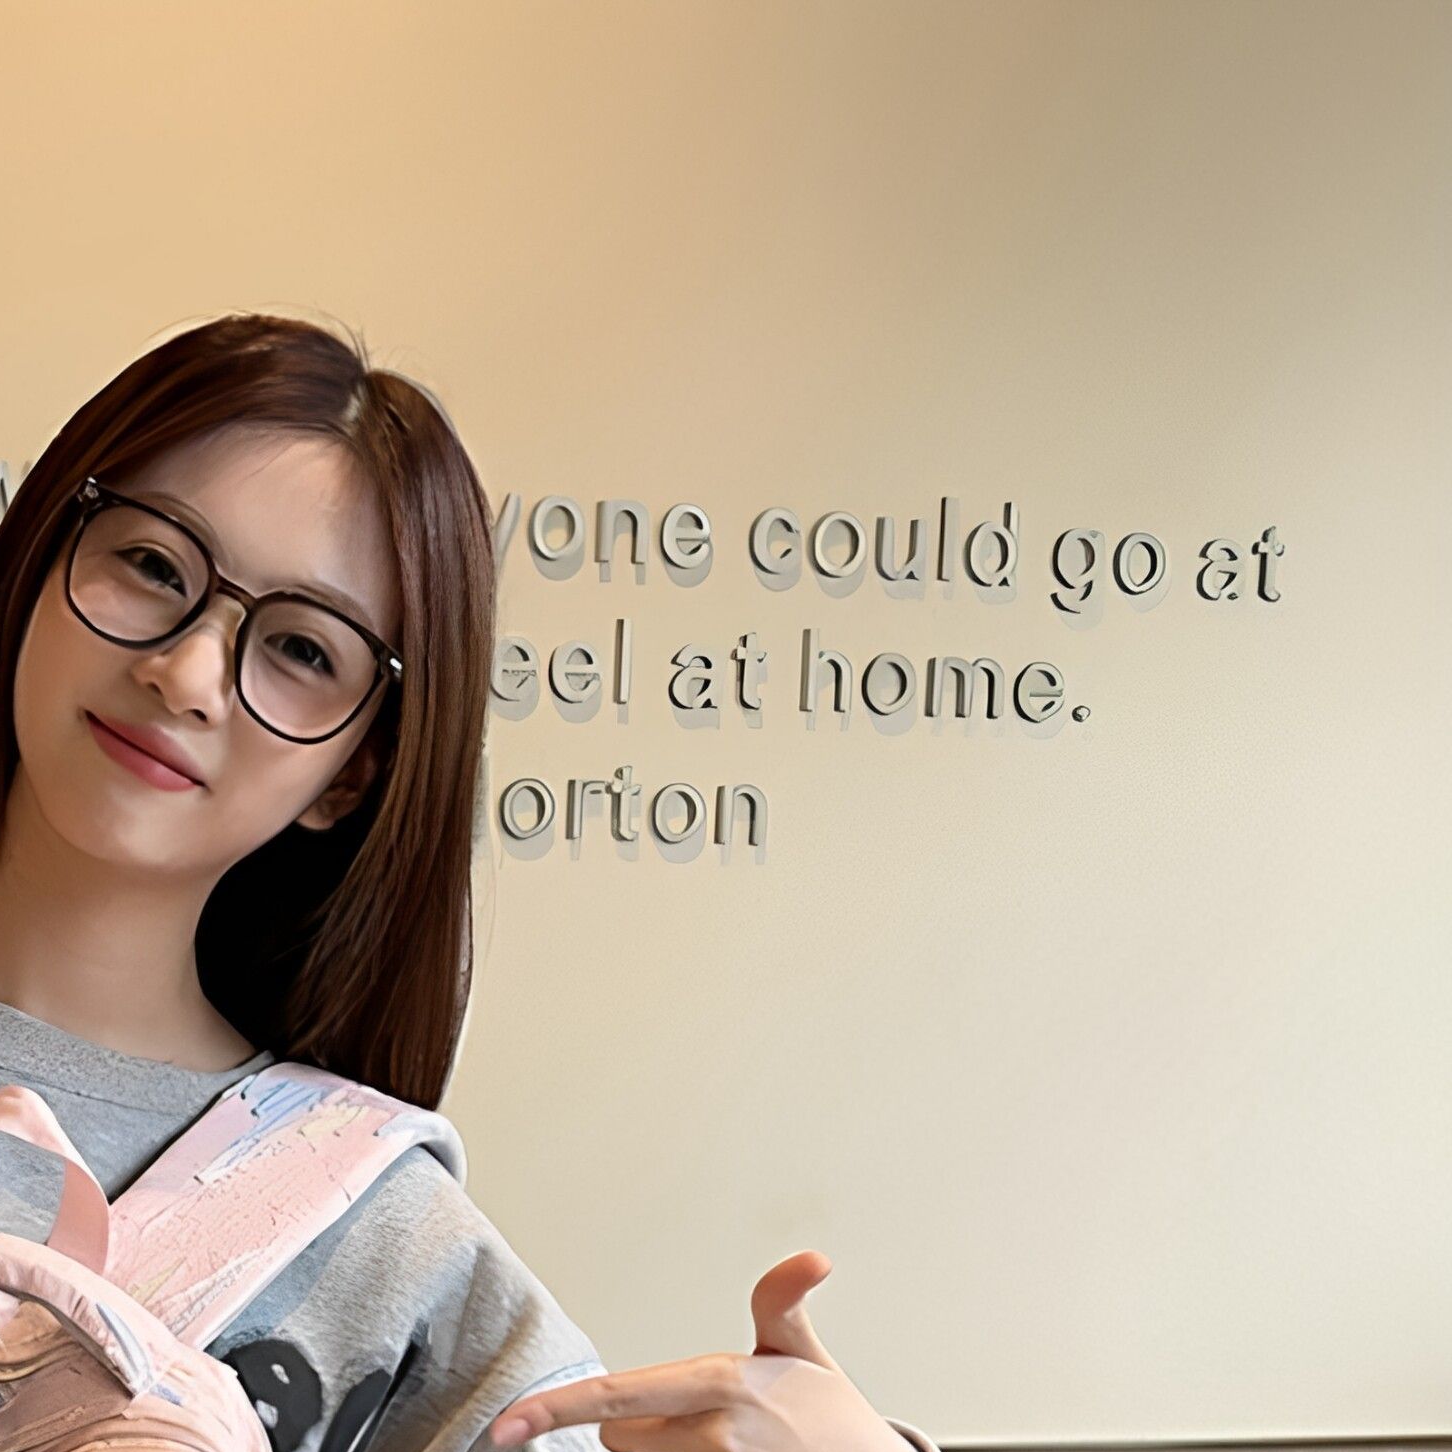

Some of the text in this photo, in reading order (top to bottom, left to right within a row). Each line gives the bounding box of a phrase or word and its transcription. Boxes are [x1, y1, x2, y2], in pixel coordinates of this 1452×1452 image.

[491, 492, 712, 575] yone
[748, 496, 1019, 587] could
[1050, 527, 1167, 614] go
[1195, 525, 1286, 603] at
[489, 618, 632, 705] eel
[667, 631, 768, 711] at
[798, 628, 1091, 724] home.
[499, 765, 768, 847] orton
